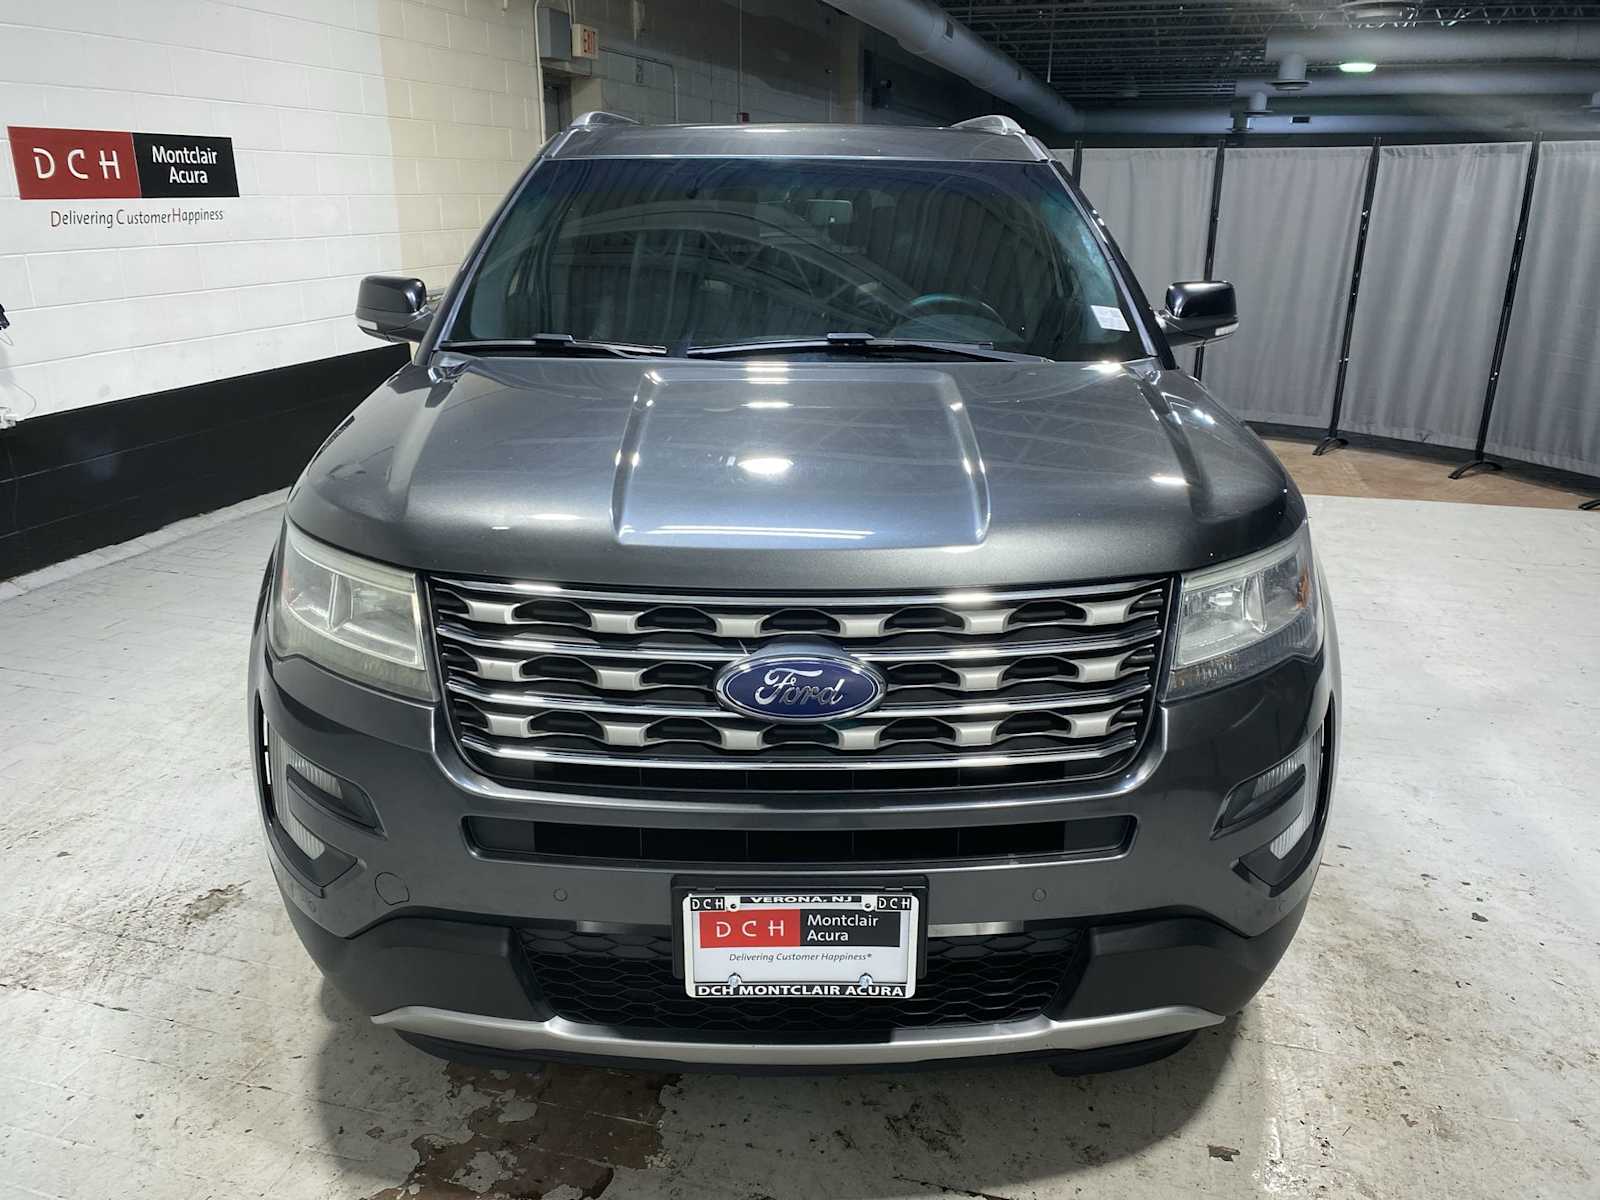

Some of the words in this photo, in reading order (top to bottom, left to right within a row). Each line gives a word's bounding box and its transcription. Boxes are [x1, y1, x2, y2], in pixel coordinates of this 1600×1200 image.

[152, 145, 218, 165] Montclair
[169, 167, 208, 184] Acura
[51, 210, 113, 229] Delivering
[754, 667, 846, 706] Ford
[691, 898, 724, 910] DCH
[878, 898, 911, 909] DCH
[807, 914, 879, 927] Montclair
[807, 930, 849, 941] Acura
[729, 953, 775, 963] Delivering
[776, 953, 820, 962] Customer
[698, 986, 734, 997] DCH
[738, 986, 843, 996] MONTCLAIR
[845, 986, 904, 997] ACURA
